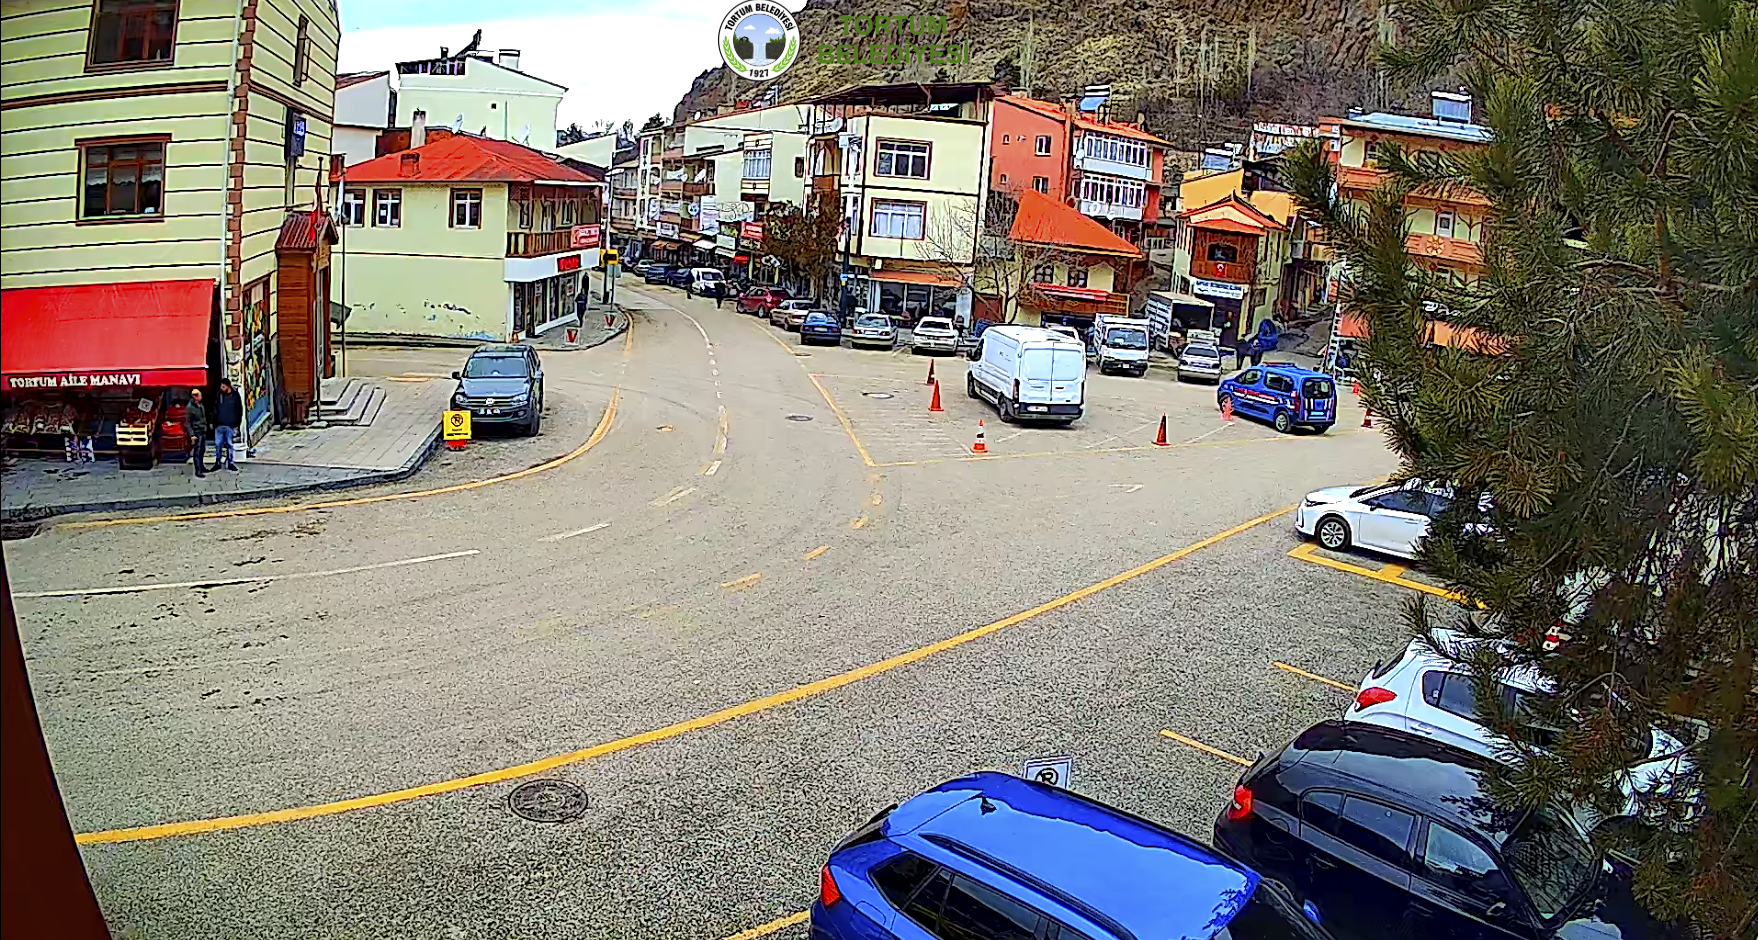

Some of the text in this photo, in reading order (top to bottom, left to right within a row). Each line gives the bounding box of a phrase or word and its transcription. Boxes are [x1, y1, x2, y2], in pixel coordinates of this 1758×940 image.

[9, 373, 141, 388] TORTUM AİLE MANAVI
